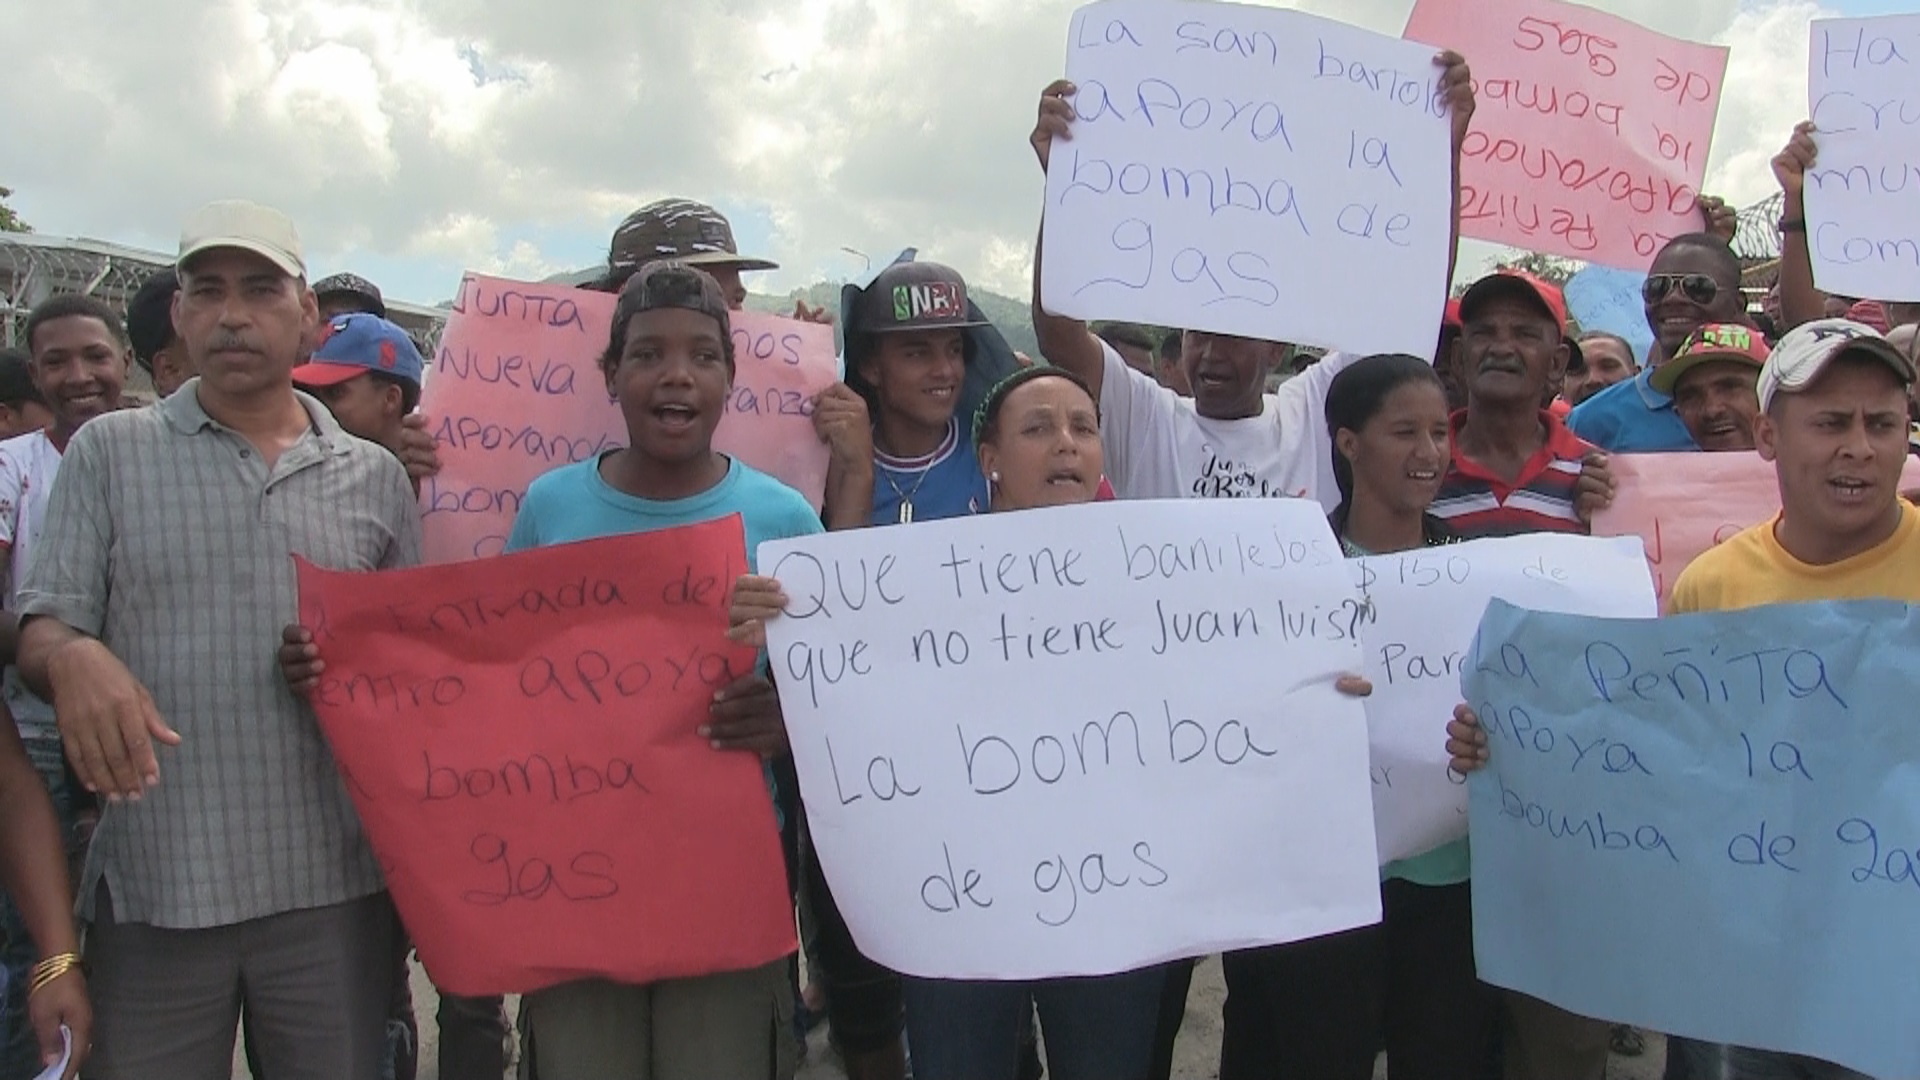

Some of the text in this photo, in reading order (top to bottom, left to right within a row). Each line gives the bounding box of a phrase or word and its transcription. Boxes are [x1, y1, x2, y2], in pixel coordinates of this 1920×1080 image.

[1079, 14, 1143, 48] La
[1176, 20, 1277, 65] san
[1512, 15, 1712, 107] de gas
[1347, 130, 1403, 188] la
[1810, 163, 1920, 195] mu
[1060, 149, 1411, 247] bomba de
[1072, 217, 1279, 307] gas
[731, 327, 802, 365] nos
[940, 543, 1087, 600] tiene
[787, 639, 872, 707] que
[911, 628, 970, 669] no
[989, 613, 1125, 662] tiene
[422, 750, 650, 802] bomba
[825, 700, 1279, 805] La bomba
[1740, 732, 1814, 781] la
[463, 833, 619, 906] gas
[921, 841, 1170, 926] de gas
[1727, 820, 1800, 873] de
[1836, 817, 1920, 888] ga
